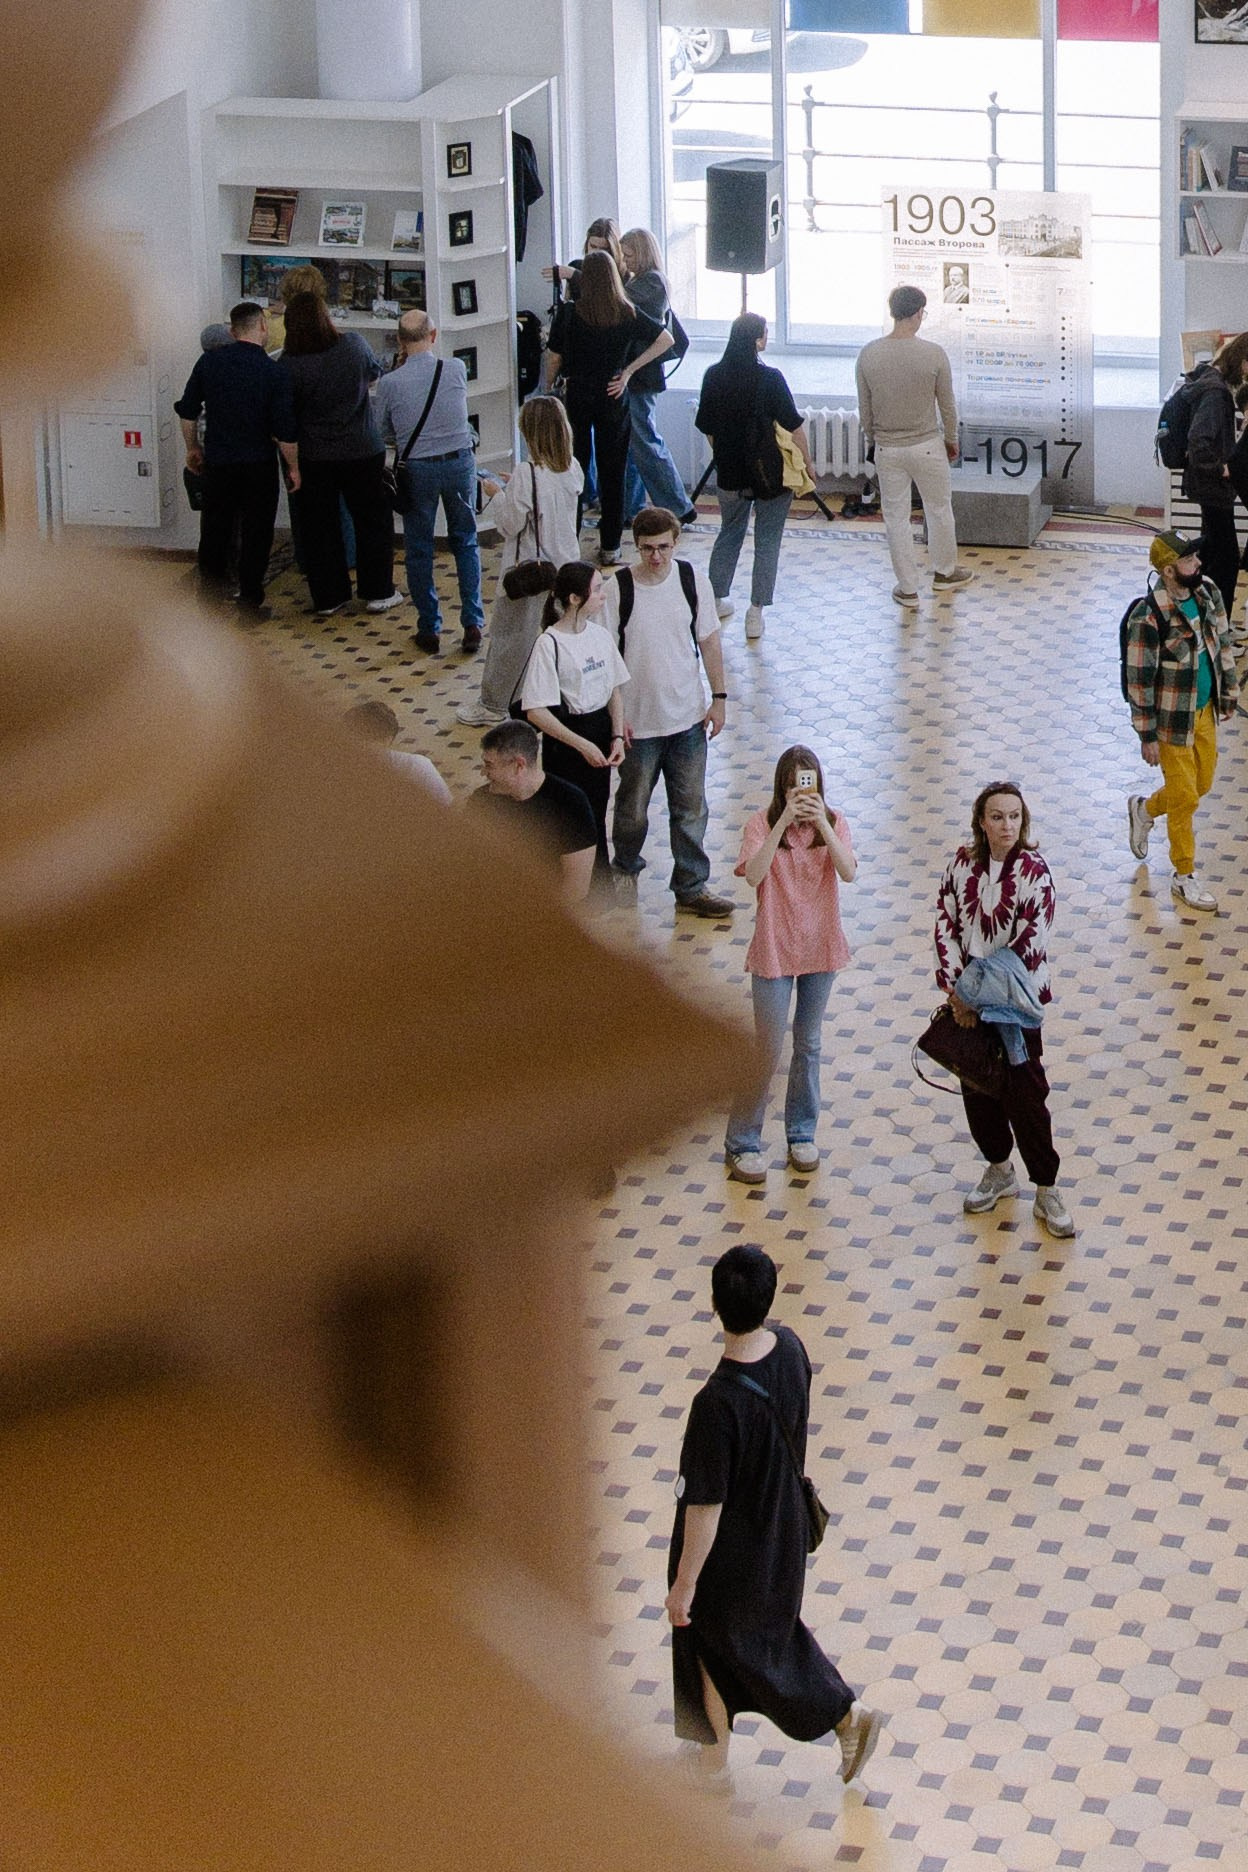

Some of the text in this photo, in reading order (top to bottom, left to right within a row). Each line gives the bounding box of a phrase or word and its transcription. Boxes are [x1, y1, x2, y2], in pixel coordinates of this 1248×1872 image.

[884, 194, 996, 236] 1903
[894, 237, 985, 249] Пассаж Второва
